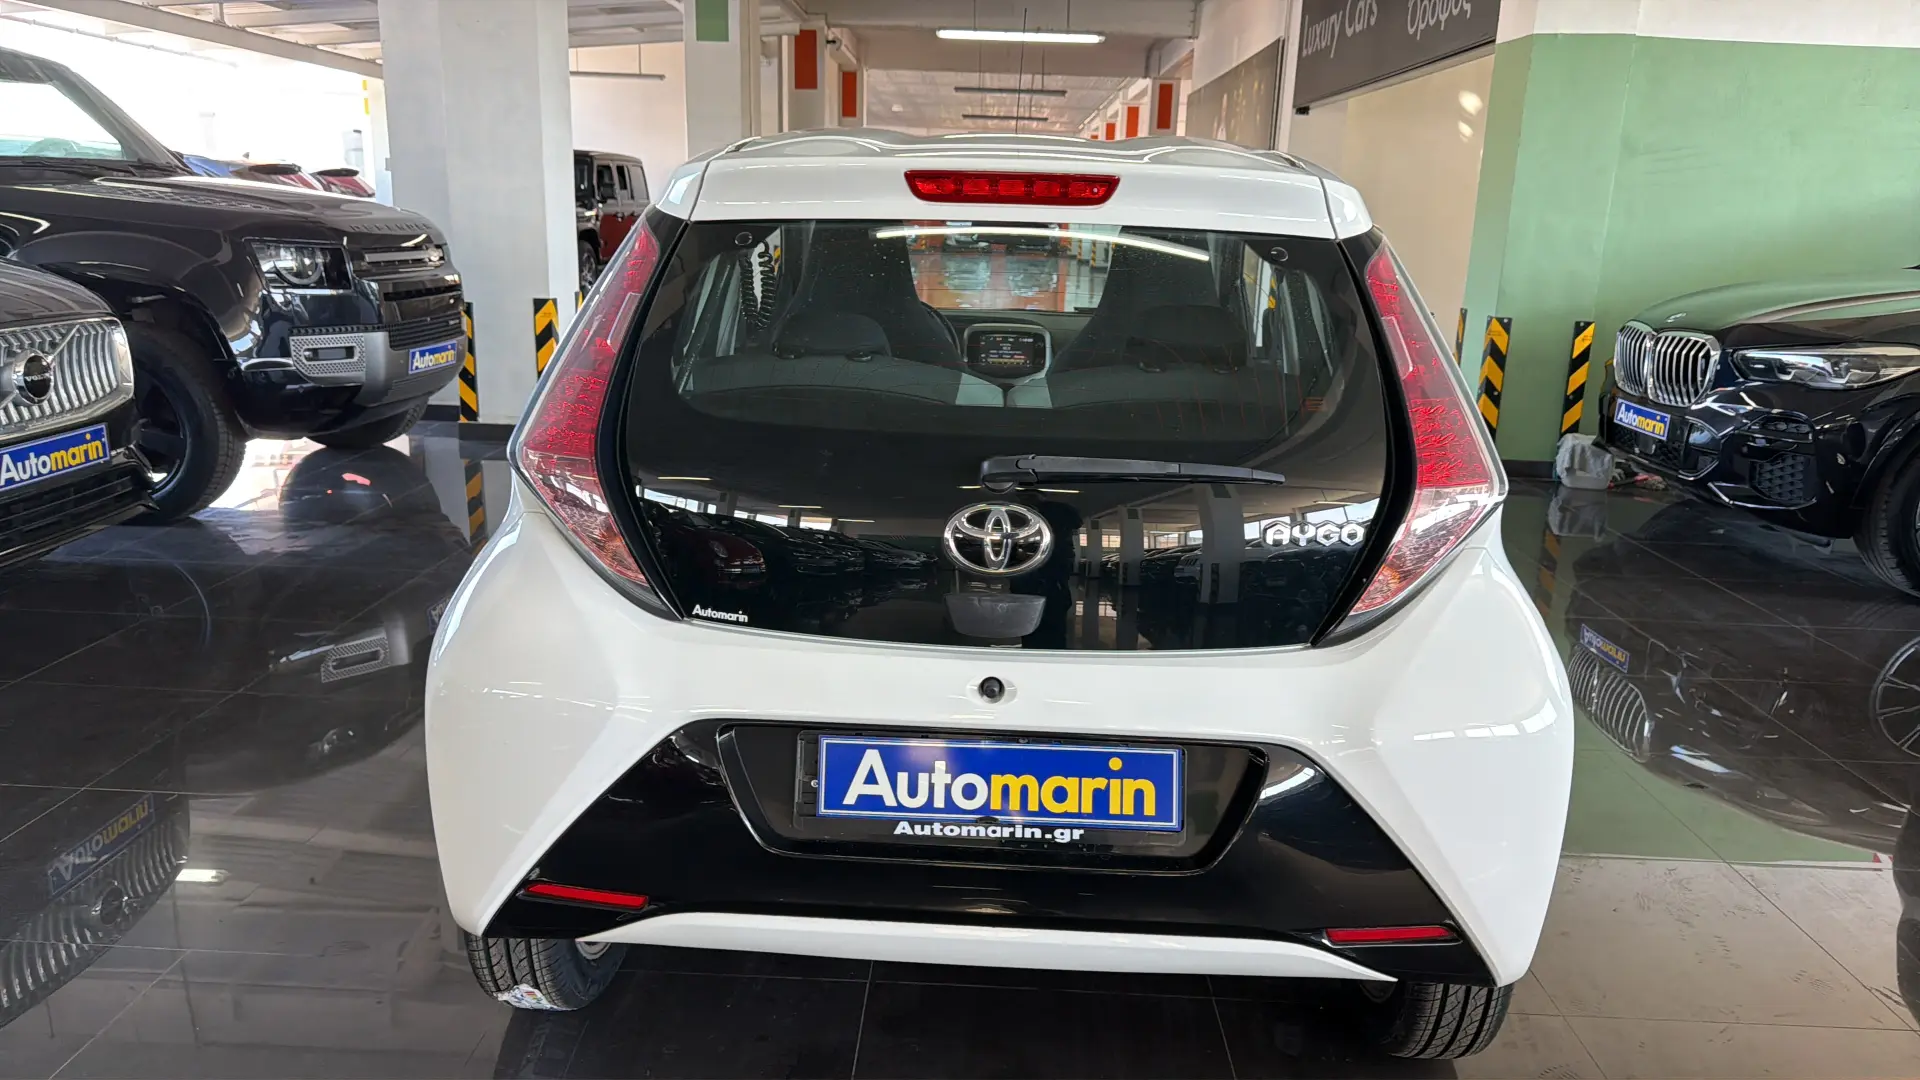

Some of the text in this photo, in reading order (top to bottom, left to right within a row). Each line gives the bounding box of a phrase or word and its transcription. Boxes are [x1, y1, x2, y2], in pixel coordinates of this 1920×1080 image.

[1302, 0, 1377, 58] Luxury Cars
[413, 344, 454, 370] Automarin
[1617, 403, 1665, 435] Automarin
[0, 433, 103, 486] Automarin
[1264, 520, 1365, 547] AYGO
[692, 604, 748, 622] Automarin
[842, 749, 1156, 816] Automarin
[894, 821, 1084, 843] Automarin.gr
